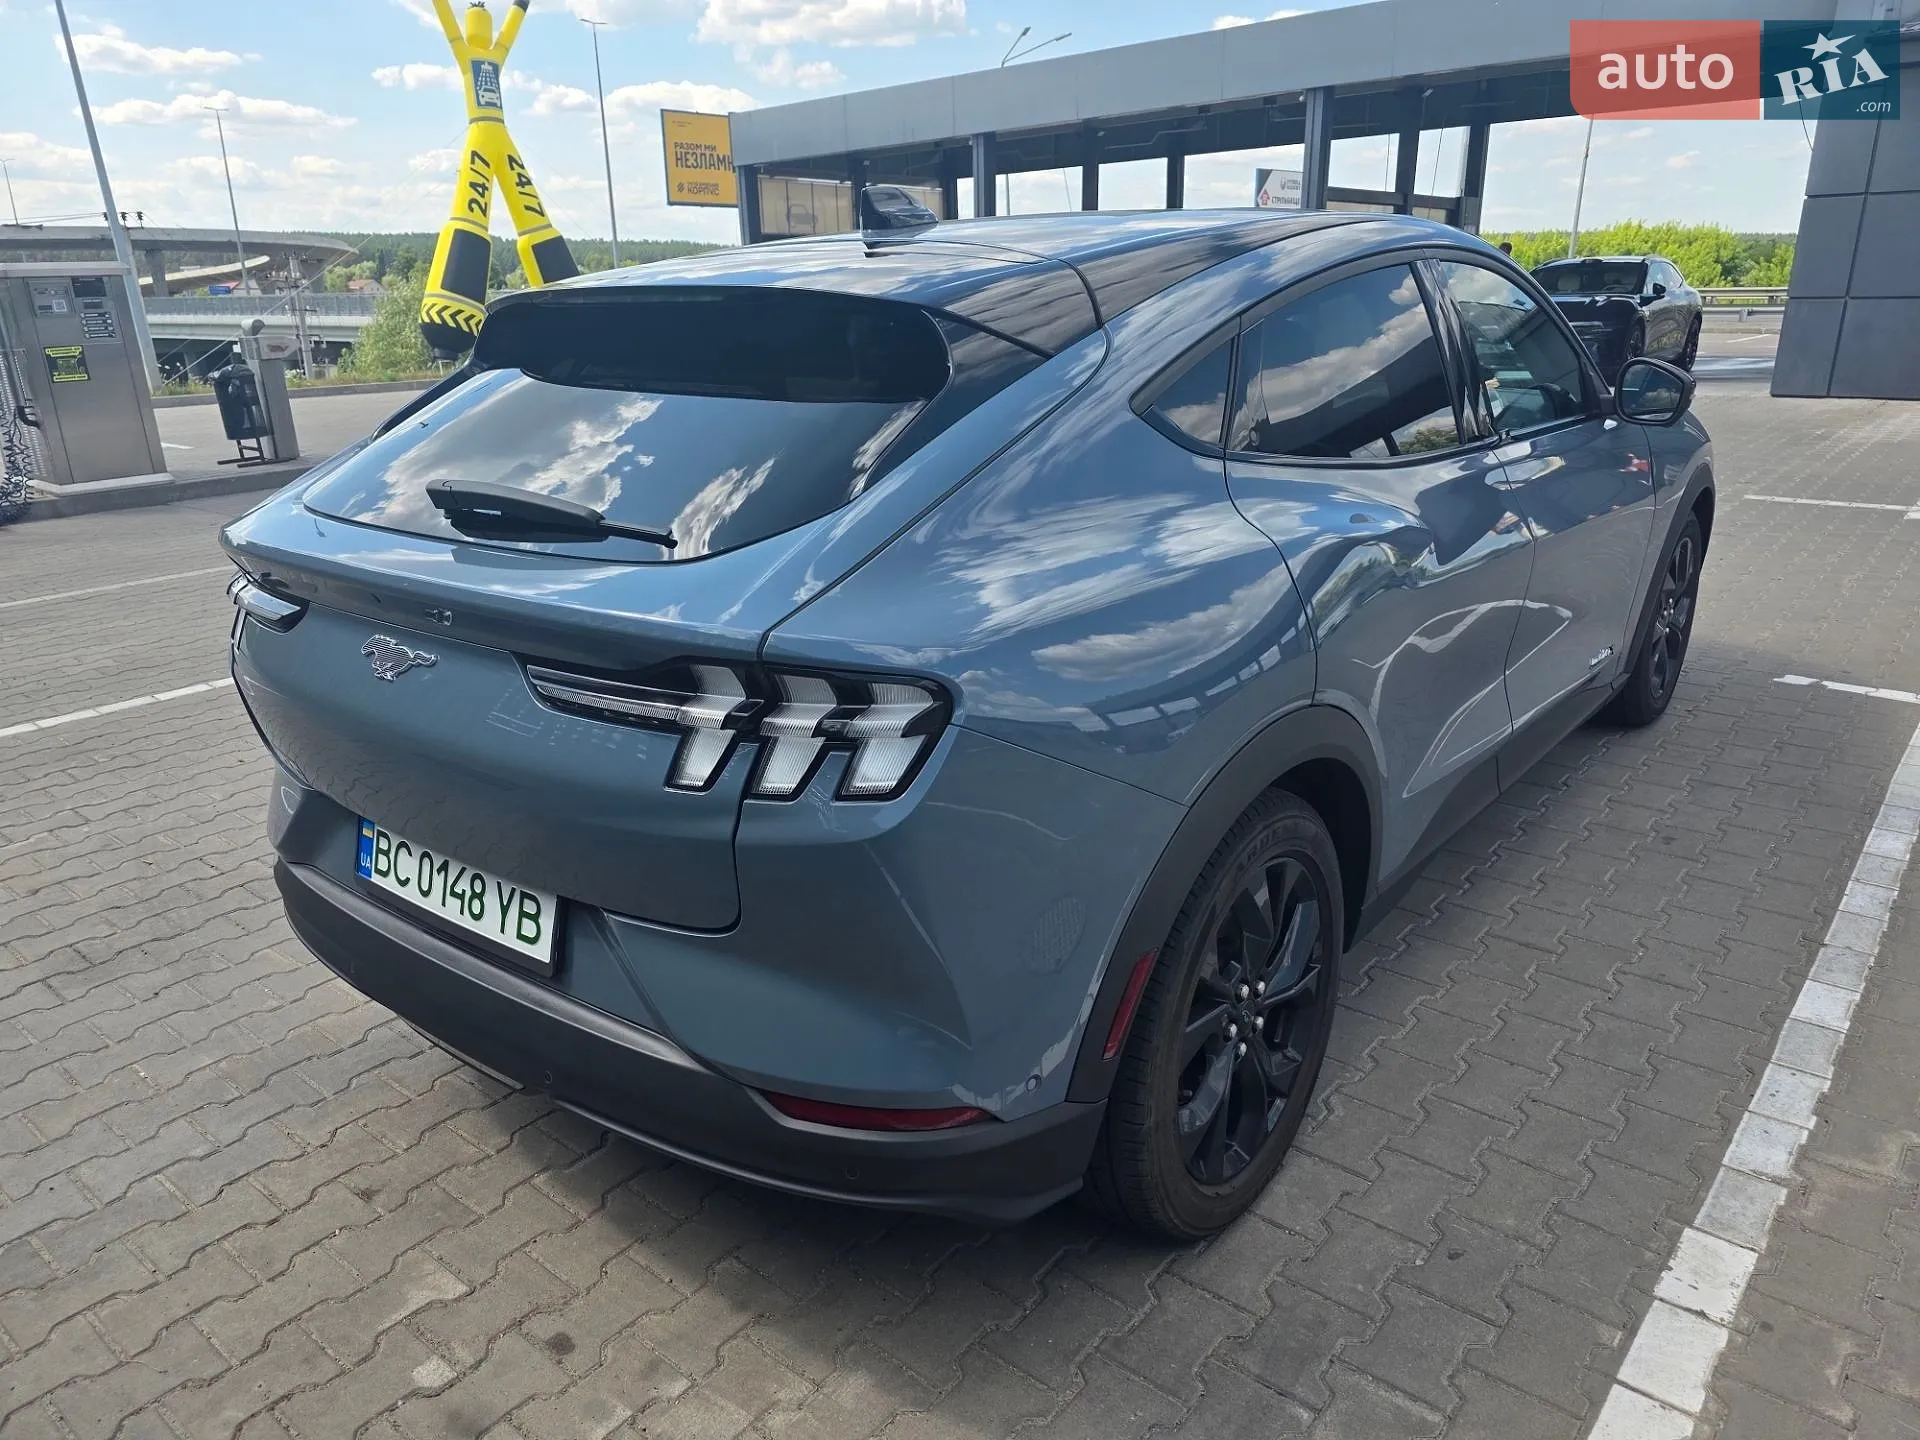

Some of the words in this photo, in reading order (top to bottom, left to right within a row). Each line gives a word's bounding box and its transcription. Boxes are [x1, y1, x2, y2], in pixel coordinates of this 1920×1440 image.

[674, 141, 702, 151] РАЗОМ
[704, 144, 717, 153] МИ
[467, 150, 491, 218] 24/7
[507, 153, 546, 218] 24/7
[360, 852, 372, 870] UA
[496, 879, 542, 946] YB
